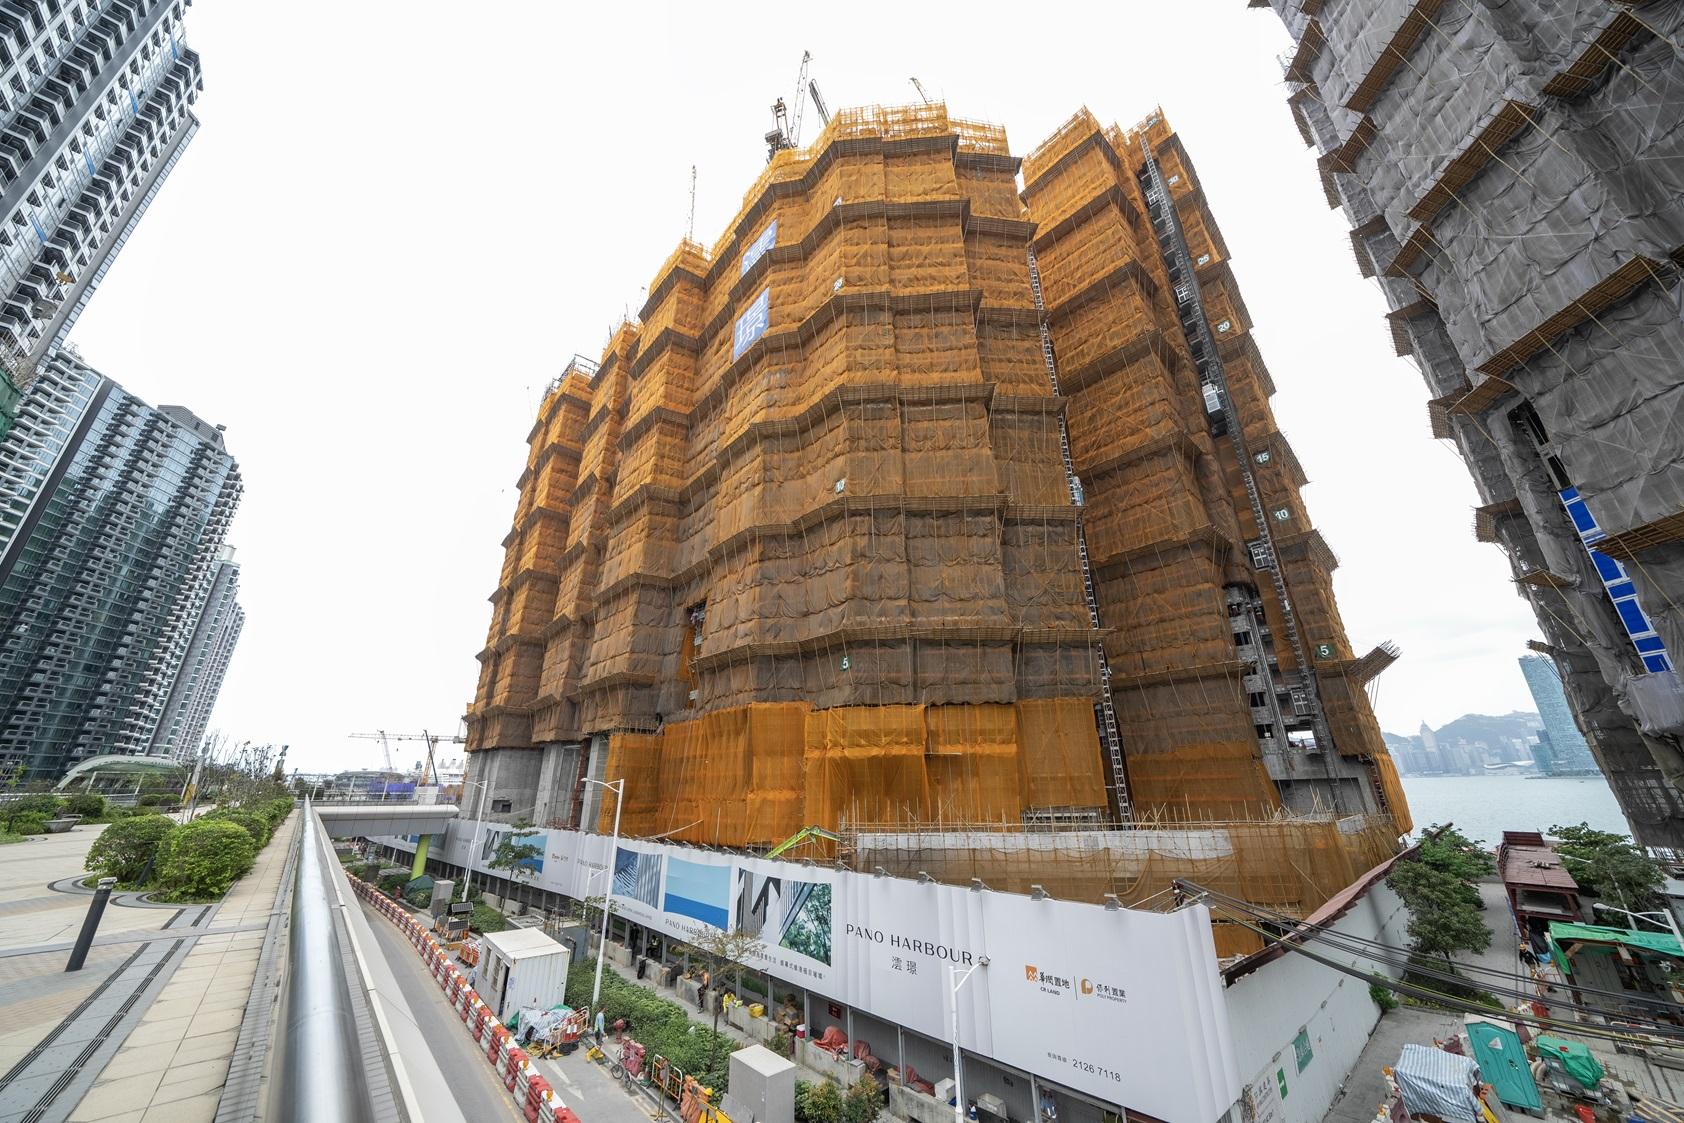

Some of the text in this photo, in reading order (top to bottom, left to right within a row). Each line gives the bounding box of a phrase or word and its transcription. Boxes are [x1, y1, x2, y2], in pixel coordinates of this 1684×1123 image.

[1217, 321, 1230, 333] 20
[1256, 452, 1269, 463] 15
[1275, 509, 1288, 520] 10
[1320, 645, 1329, 656] 5
[842, 657, 849, 669] 5
[846, 923, 973, 966] PANO HARBOUR
[1072, 1058, 1121, 1082] 2126 7118
